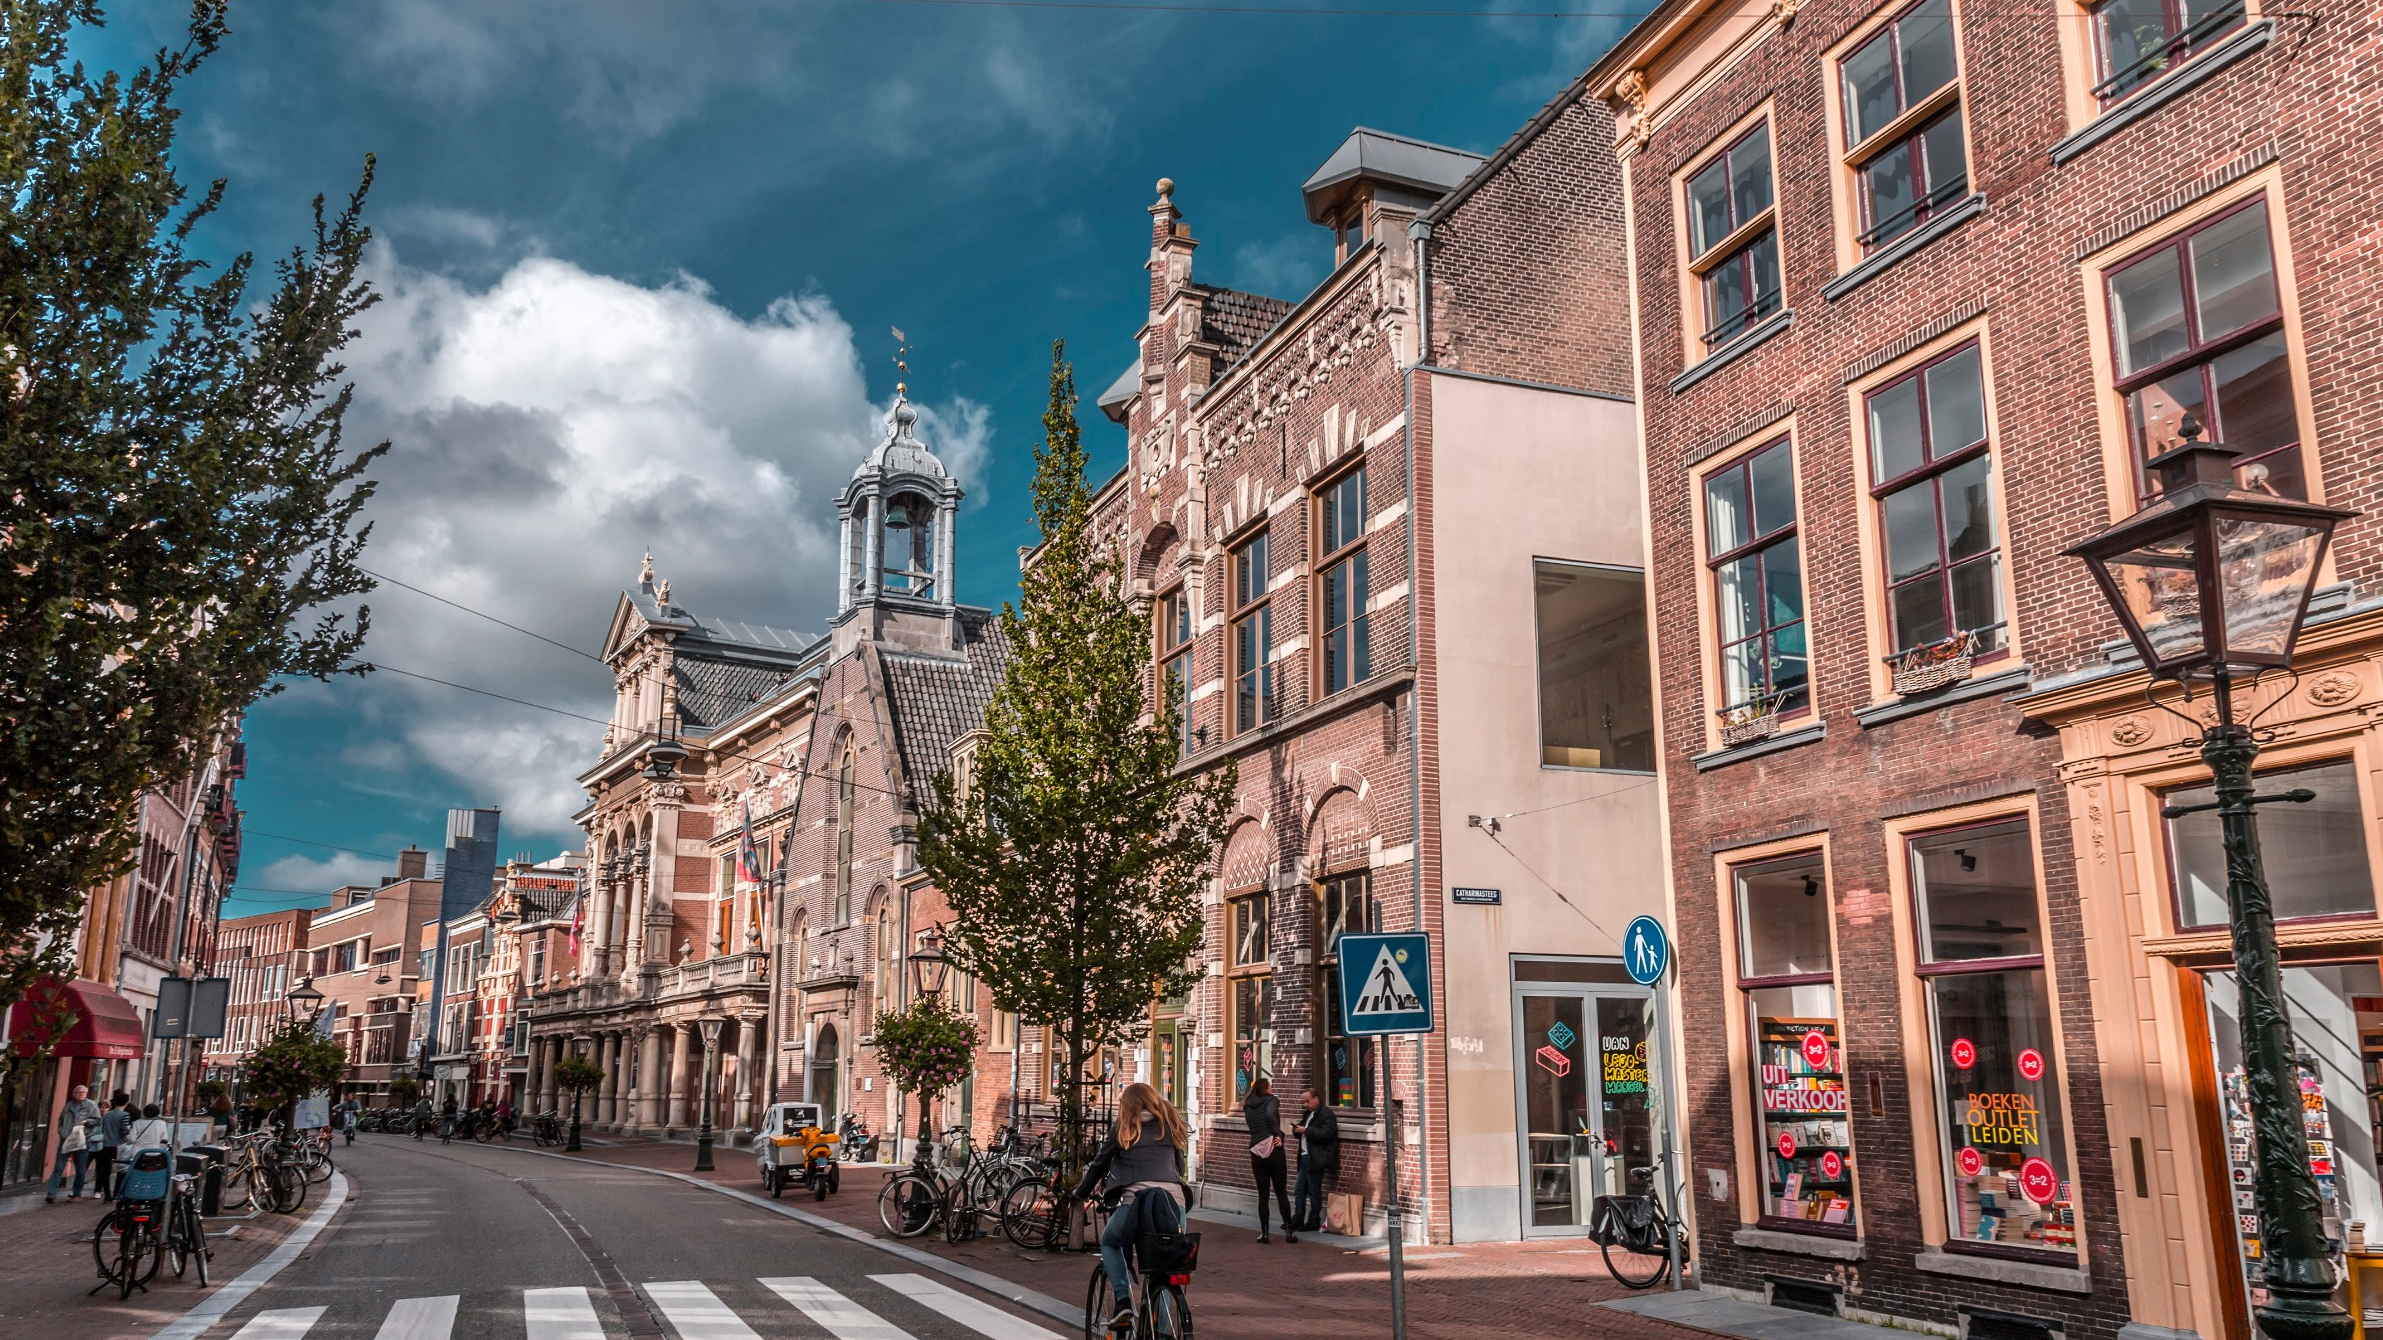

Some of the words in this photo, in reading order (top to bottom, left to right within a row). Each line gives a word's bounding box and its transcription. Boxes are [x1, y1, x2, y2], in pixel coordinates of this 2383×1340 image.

[1456, 889, 1498, 898] CATHARINASTEEG
[1603, 1036, 1629, 1051] VAN
[1809, 1045, 1823, 1055] 3=2
[1604, 1066, 1650, 1082] MASTER
[1762, 1065, 1788, 1084] UIT
[1764, 1089, 1846, 1109] VERKOOP
[1968, 1092, 2035, 1110] BOEKEN
[1967, 1108, 2040, 1128] OUTLET
[1972, 1126, 2039, 1145] LEIDEN
[1964, 1156, 1976, 1164] 3=2
[2029, 1174, 2048, 1186] 3=2
